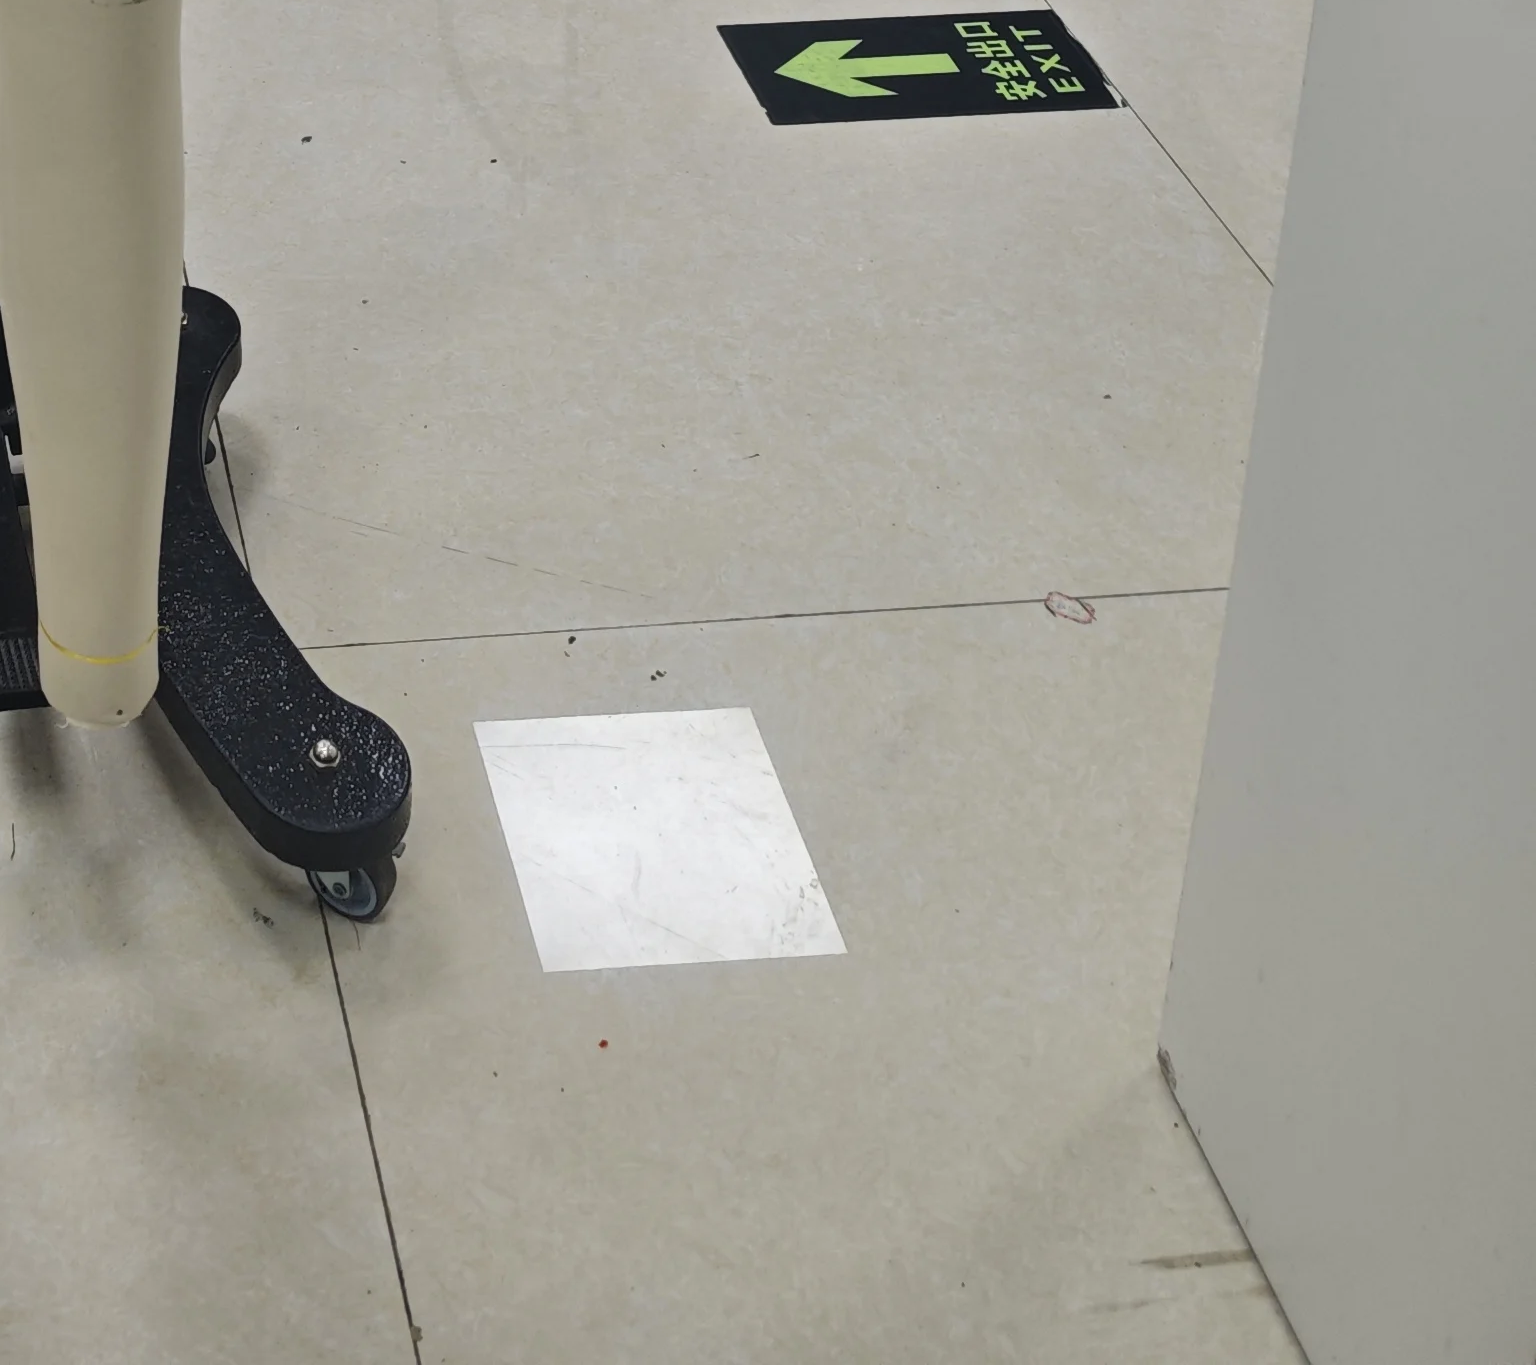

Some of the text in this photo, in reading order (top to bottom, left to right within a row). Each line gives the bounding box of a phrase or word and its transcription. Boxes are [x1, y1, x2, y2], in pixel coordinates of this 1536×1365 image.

[954, 21, 1048, 101] 安全出口
[1008, 25, 1086, 93] EXIT
